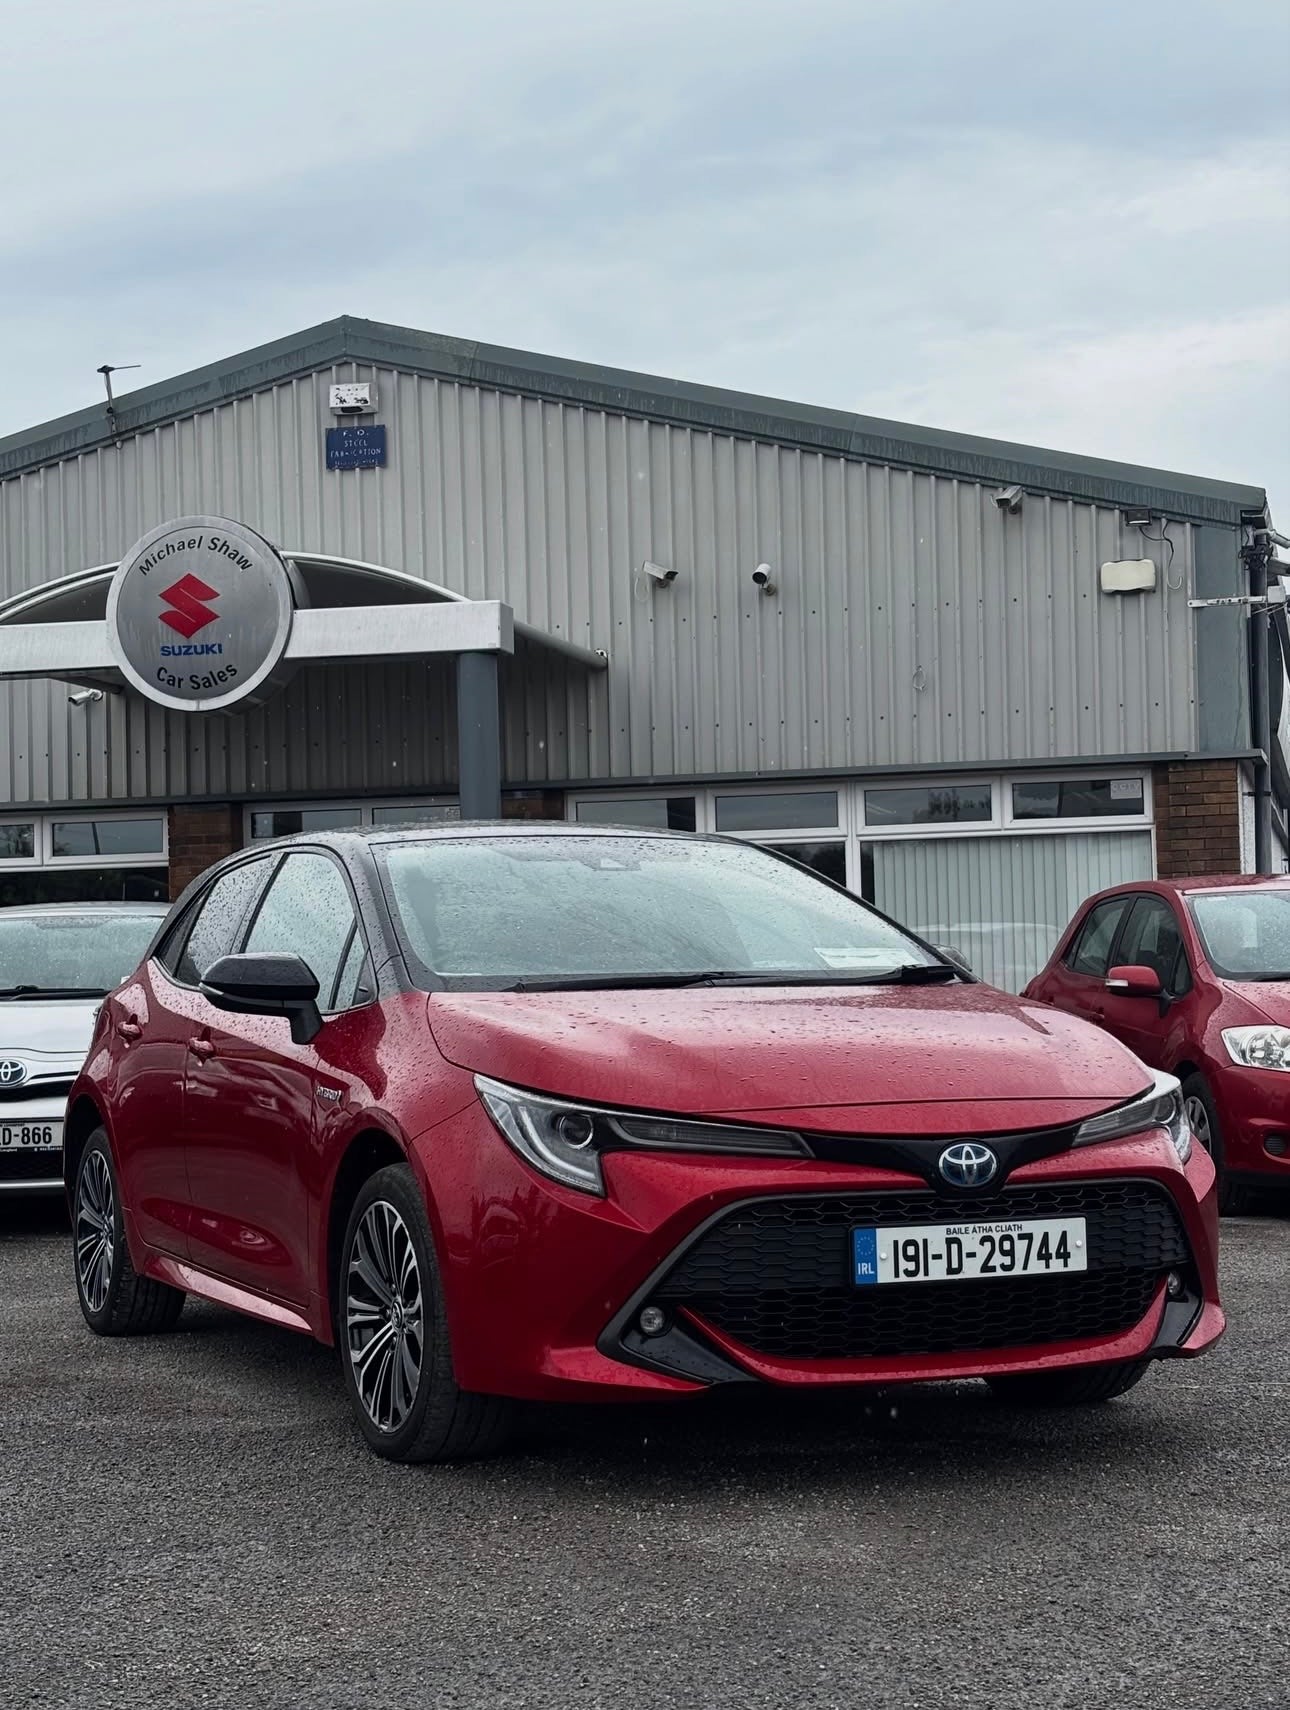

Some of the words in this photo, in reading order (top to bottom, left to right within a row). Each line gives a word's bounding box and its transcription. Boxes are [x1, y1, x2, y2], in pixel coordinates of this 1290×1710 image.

[139, 535, 204, 576] Michael
[208, 537, 253, 570] Shaw
[160, 643, 223, 656] SUZUKI
[157, 666, 184, 689] Car
[189, 664, 237, 690] Sales
[0, 1126, 53, 1146] D-866
[946, 1227, 970, 1235] BAILE
[971, 1225, 993, 1234] ÁTHA
[995, 1223, 1023, 1233] CLIATH
[893, 1230, 1071, 1279] 191-D-29744
[857, 1262, 875, 1275] IRL
